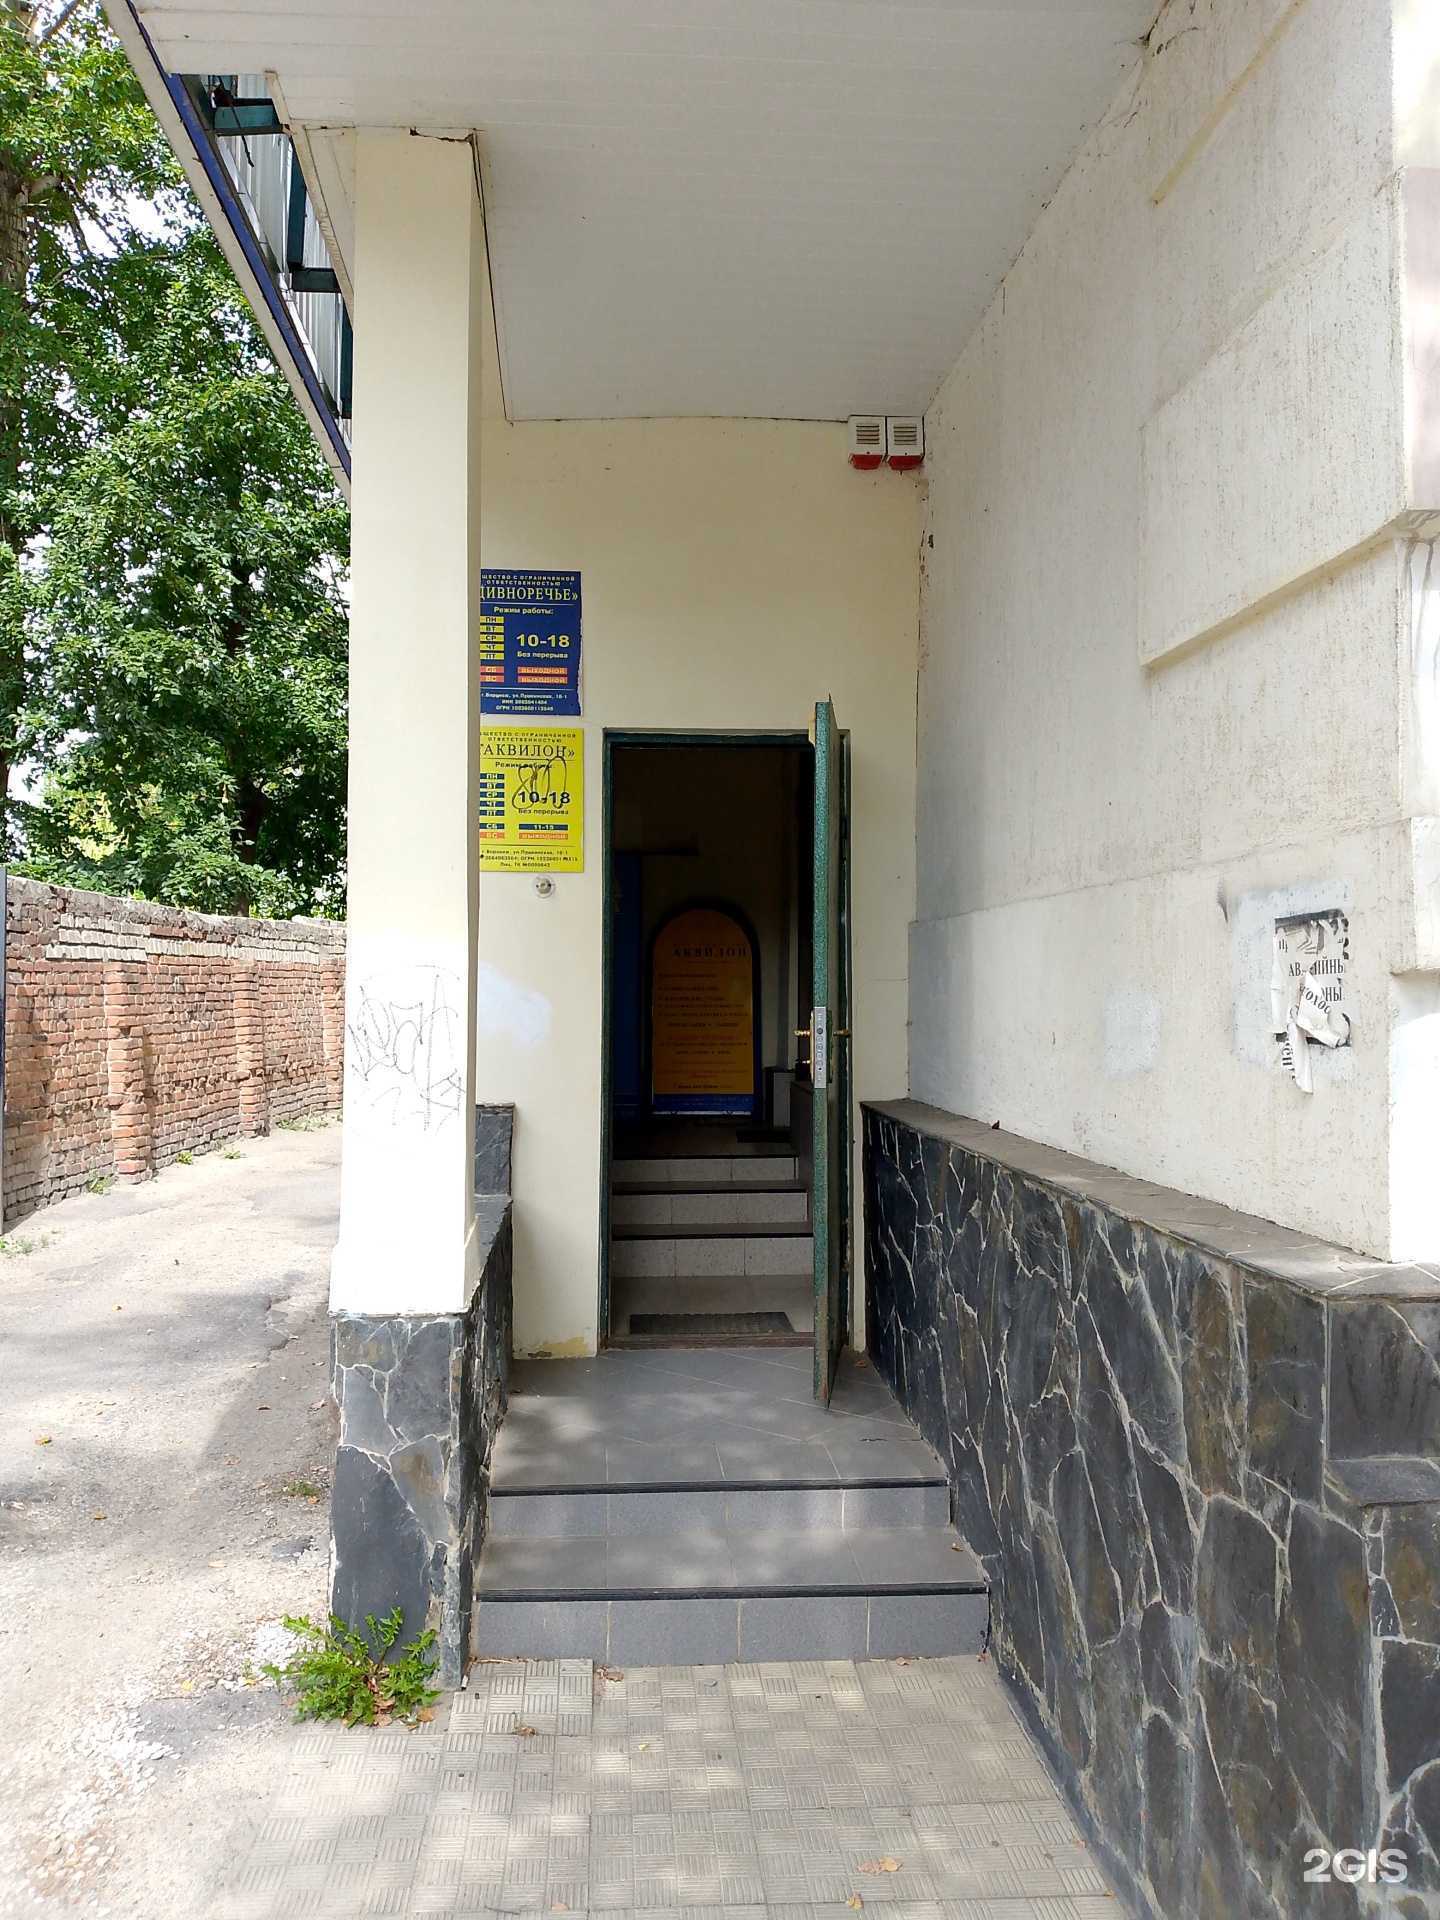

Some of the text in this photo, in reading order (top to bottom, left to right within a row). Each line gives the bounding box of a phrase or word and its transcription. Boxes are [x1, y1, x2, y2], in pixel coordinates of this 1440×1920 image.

[522, 607, 554, 615] работы:
[516, 633, 570, 648] 10-18
[518, 791, 571, 804] 10-18
